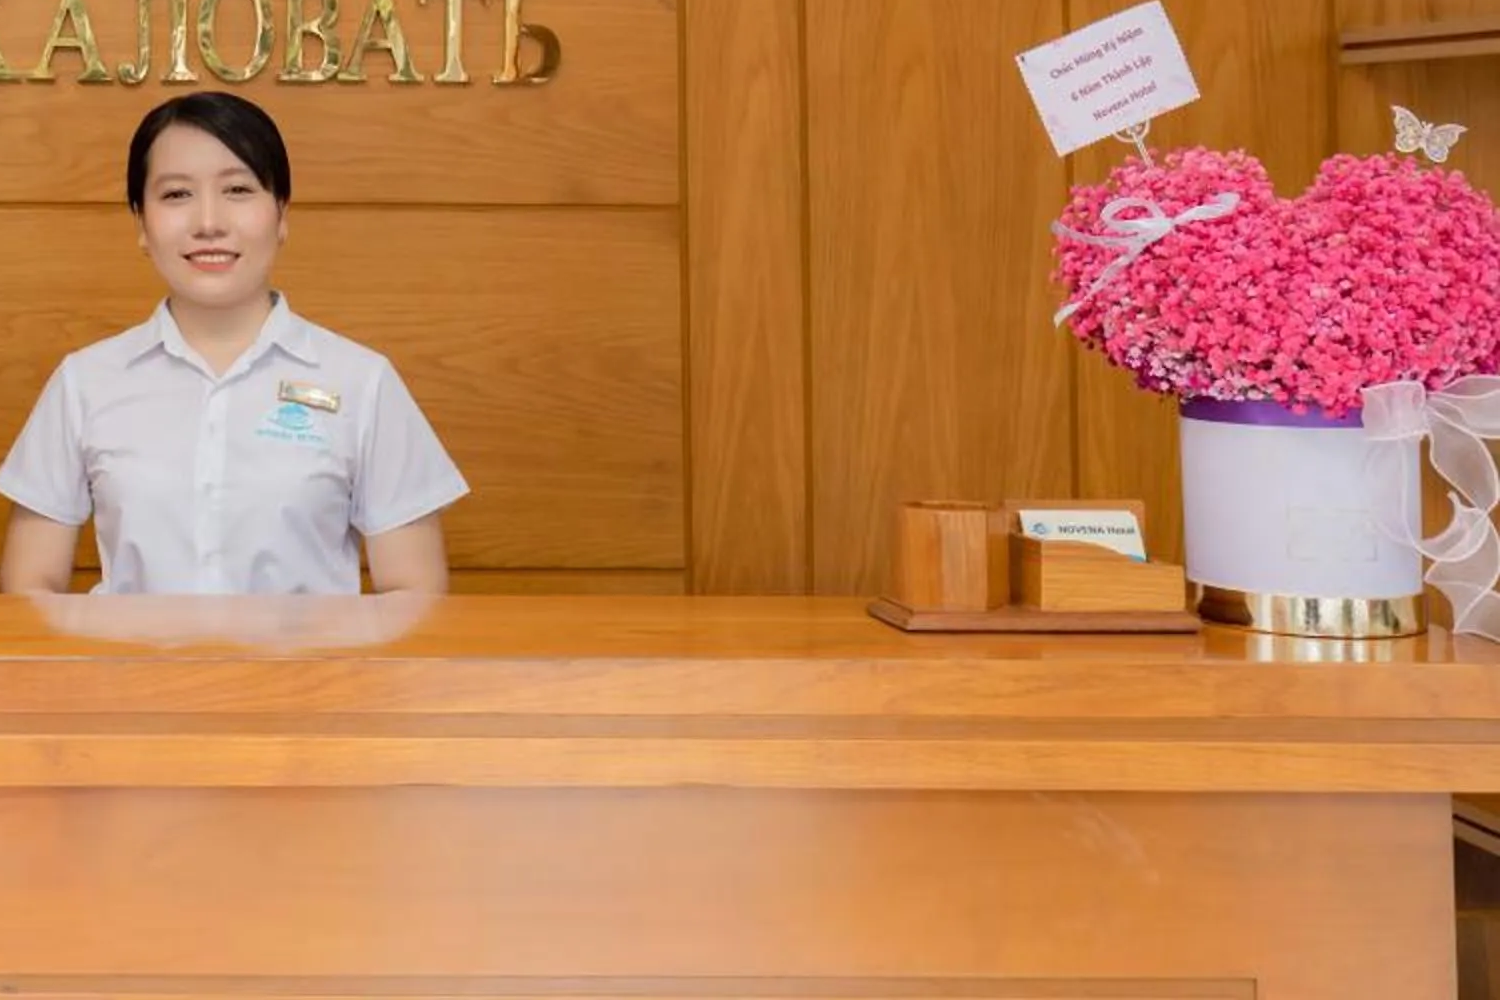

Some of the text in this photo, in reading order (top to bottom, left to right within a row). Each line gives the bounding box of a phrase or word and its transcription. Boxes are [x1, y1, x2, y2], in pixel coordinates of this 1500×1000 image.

[1093, 80, 1157, 120] Novena Hotel
[1058, 525, 1105, 535] NOVENA
